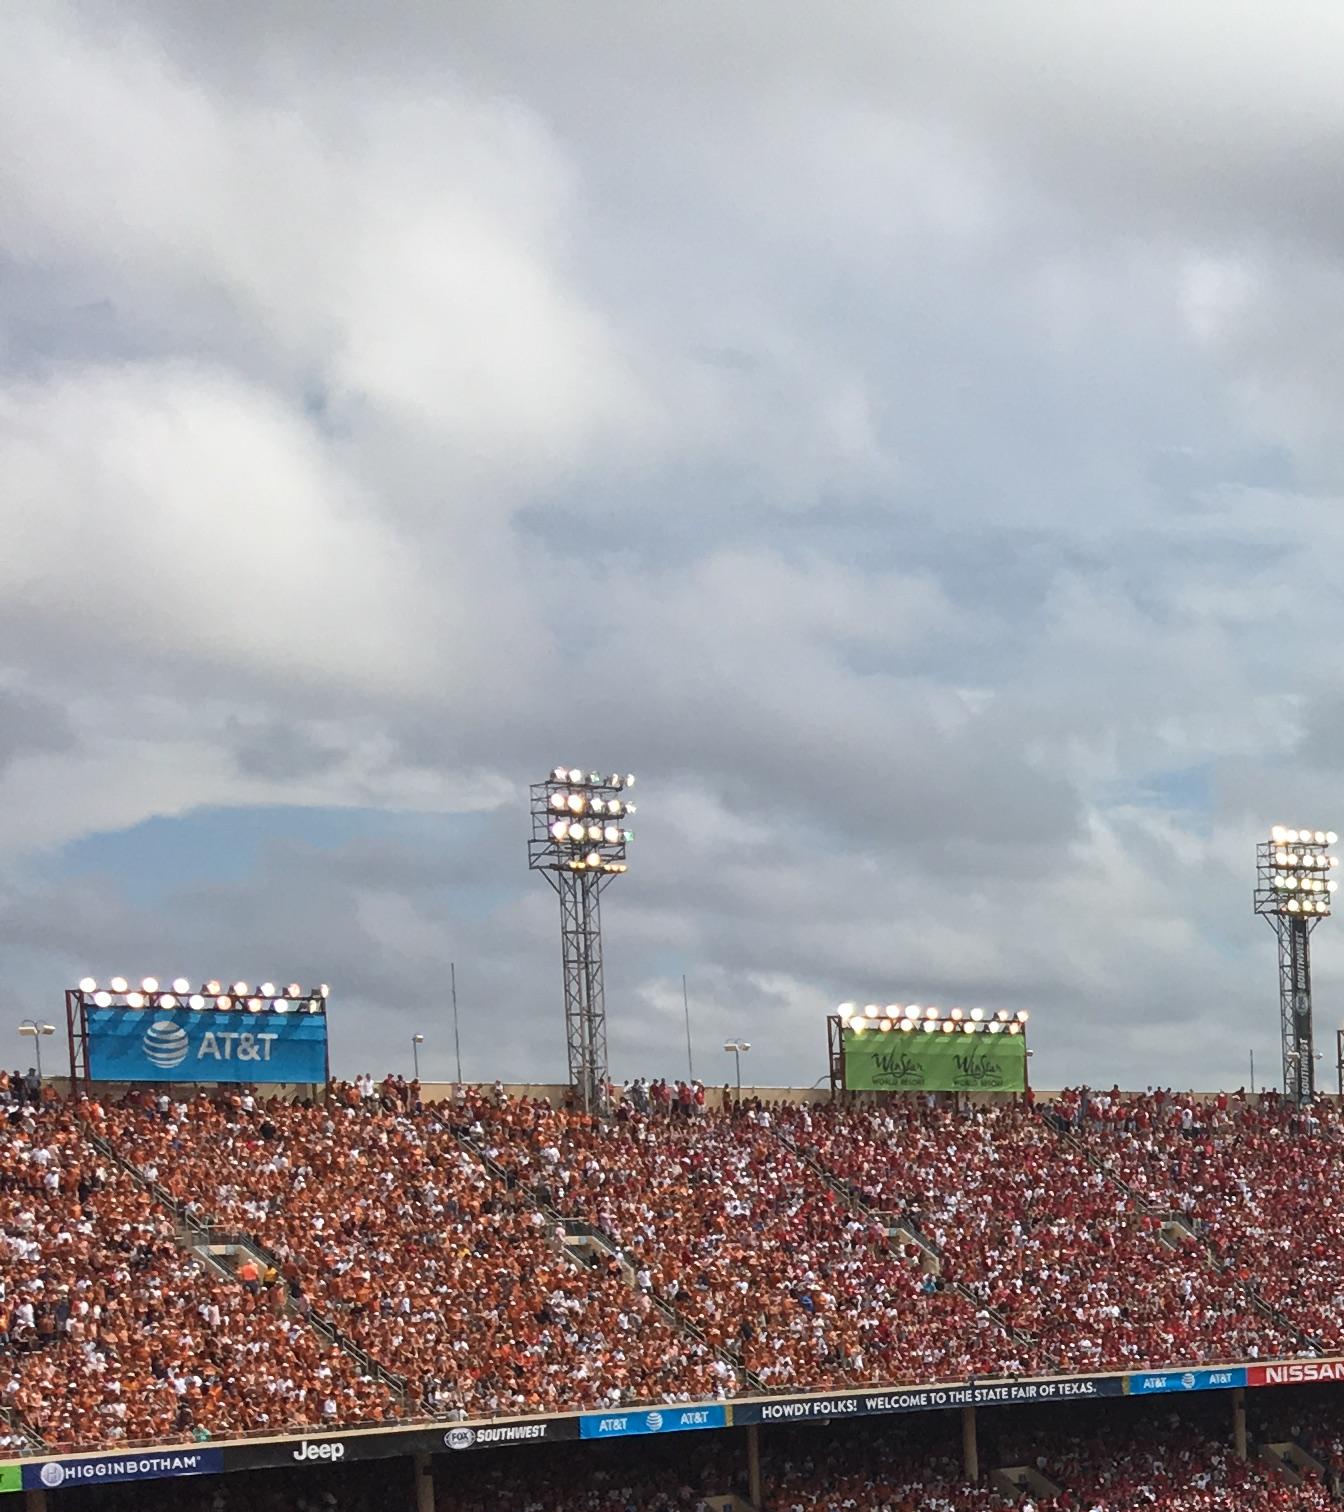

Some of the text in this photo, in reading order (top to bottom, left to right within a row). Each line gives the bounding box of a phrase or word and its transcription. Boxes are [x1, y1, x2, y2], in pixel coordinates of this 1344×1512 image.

[197, 1032, 279, 1061] AT&T
[1300, 1038, 1310, 1095] SOUTHWEST
[1143, 1377, 1167, 1388] AT&T
[1209, 1373, 1232, 1384] AT&T
[762, 1381, 1096, 1419] HOWDY FOLKS! WELCOME TO THE STATE FAIR OF TEXAS.
[599, 1418, 627, 1431] AT&T
[680, 1411, 709, 1424] AT&T
[476, 1425, 546, 1442] SOUTHWEST
[293, 1441, 344, 1461] Jeep
